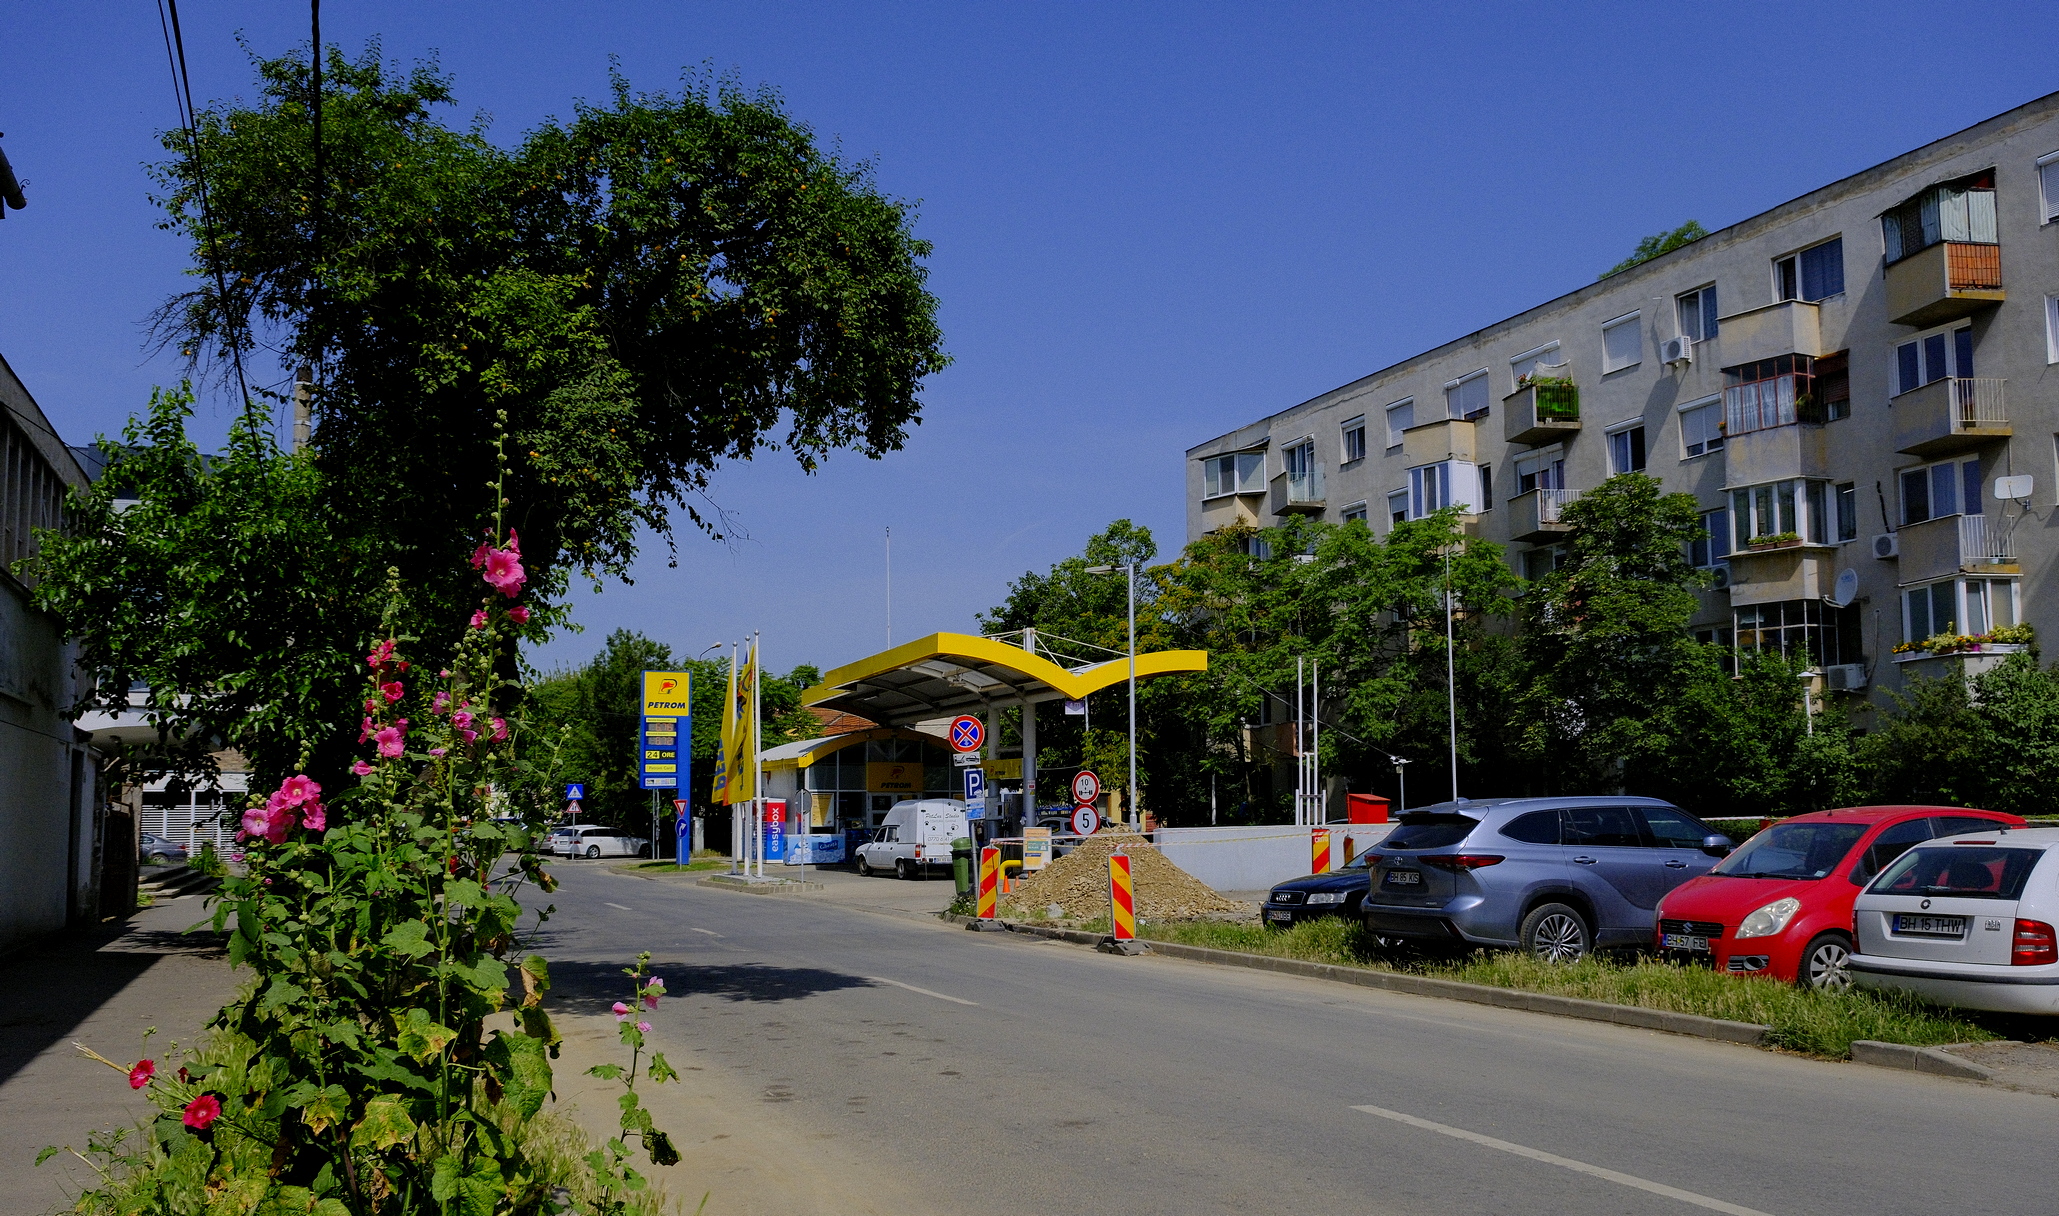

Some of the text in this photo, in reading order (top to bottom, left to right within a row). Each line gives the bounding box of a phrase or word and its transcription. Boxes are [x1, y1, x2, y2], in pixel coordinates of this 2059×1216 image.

[647, 701, 686, 709] PETROM
[968, 773, 980, 797] P
[1082, 813, 1090, 829] 5
[770, 807, 781, 852] easybox
[1390, 872, 1399, 882] BH
[1900, 917, 1962, 932] BH 15 THW
